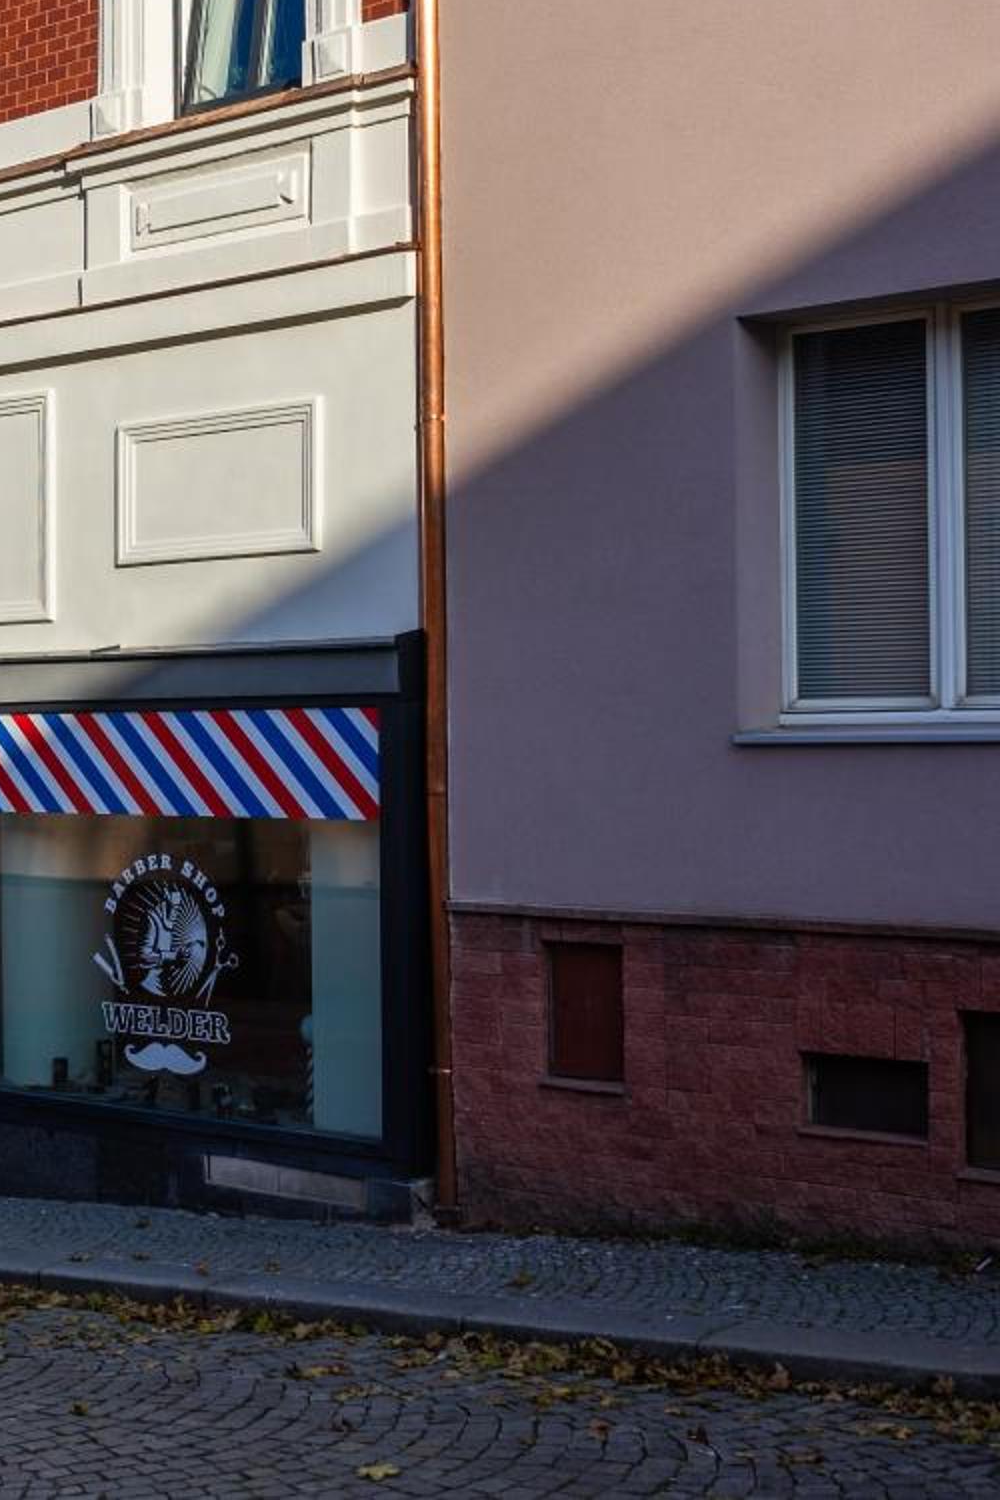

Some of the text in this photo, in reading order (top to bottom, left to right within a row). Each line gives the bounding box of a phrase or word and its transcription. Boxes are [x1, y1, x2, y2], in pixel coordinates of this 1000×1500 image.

[104, 854, 226, 918] BARBER SHOP
[102, 1001, 231, 1044] WELDER
